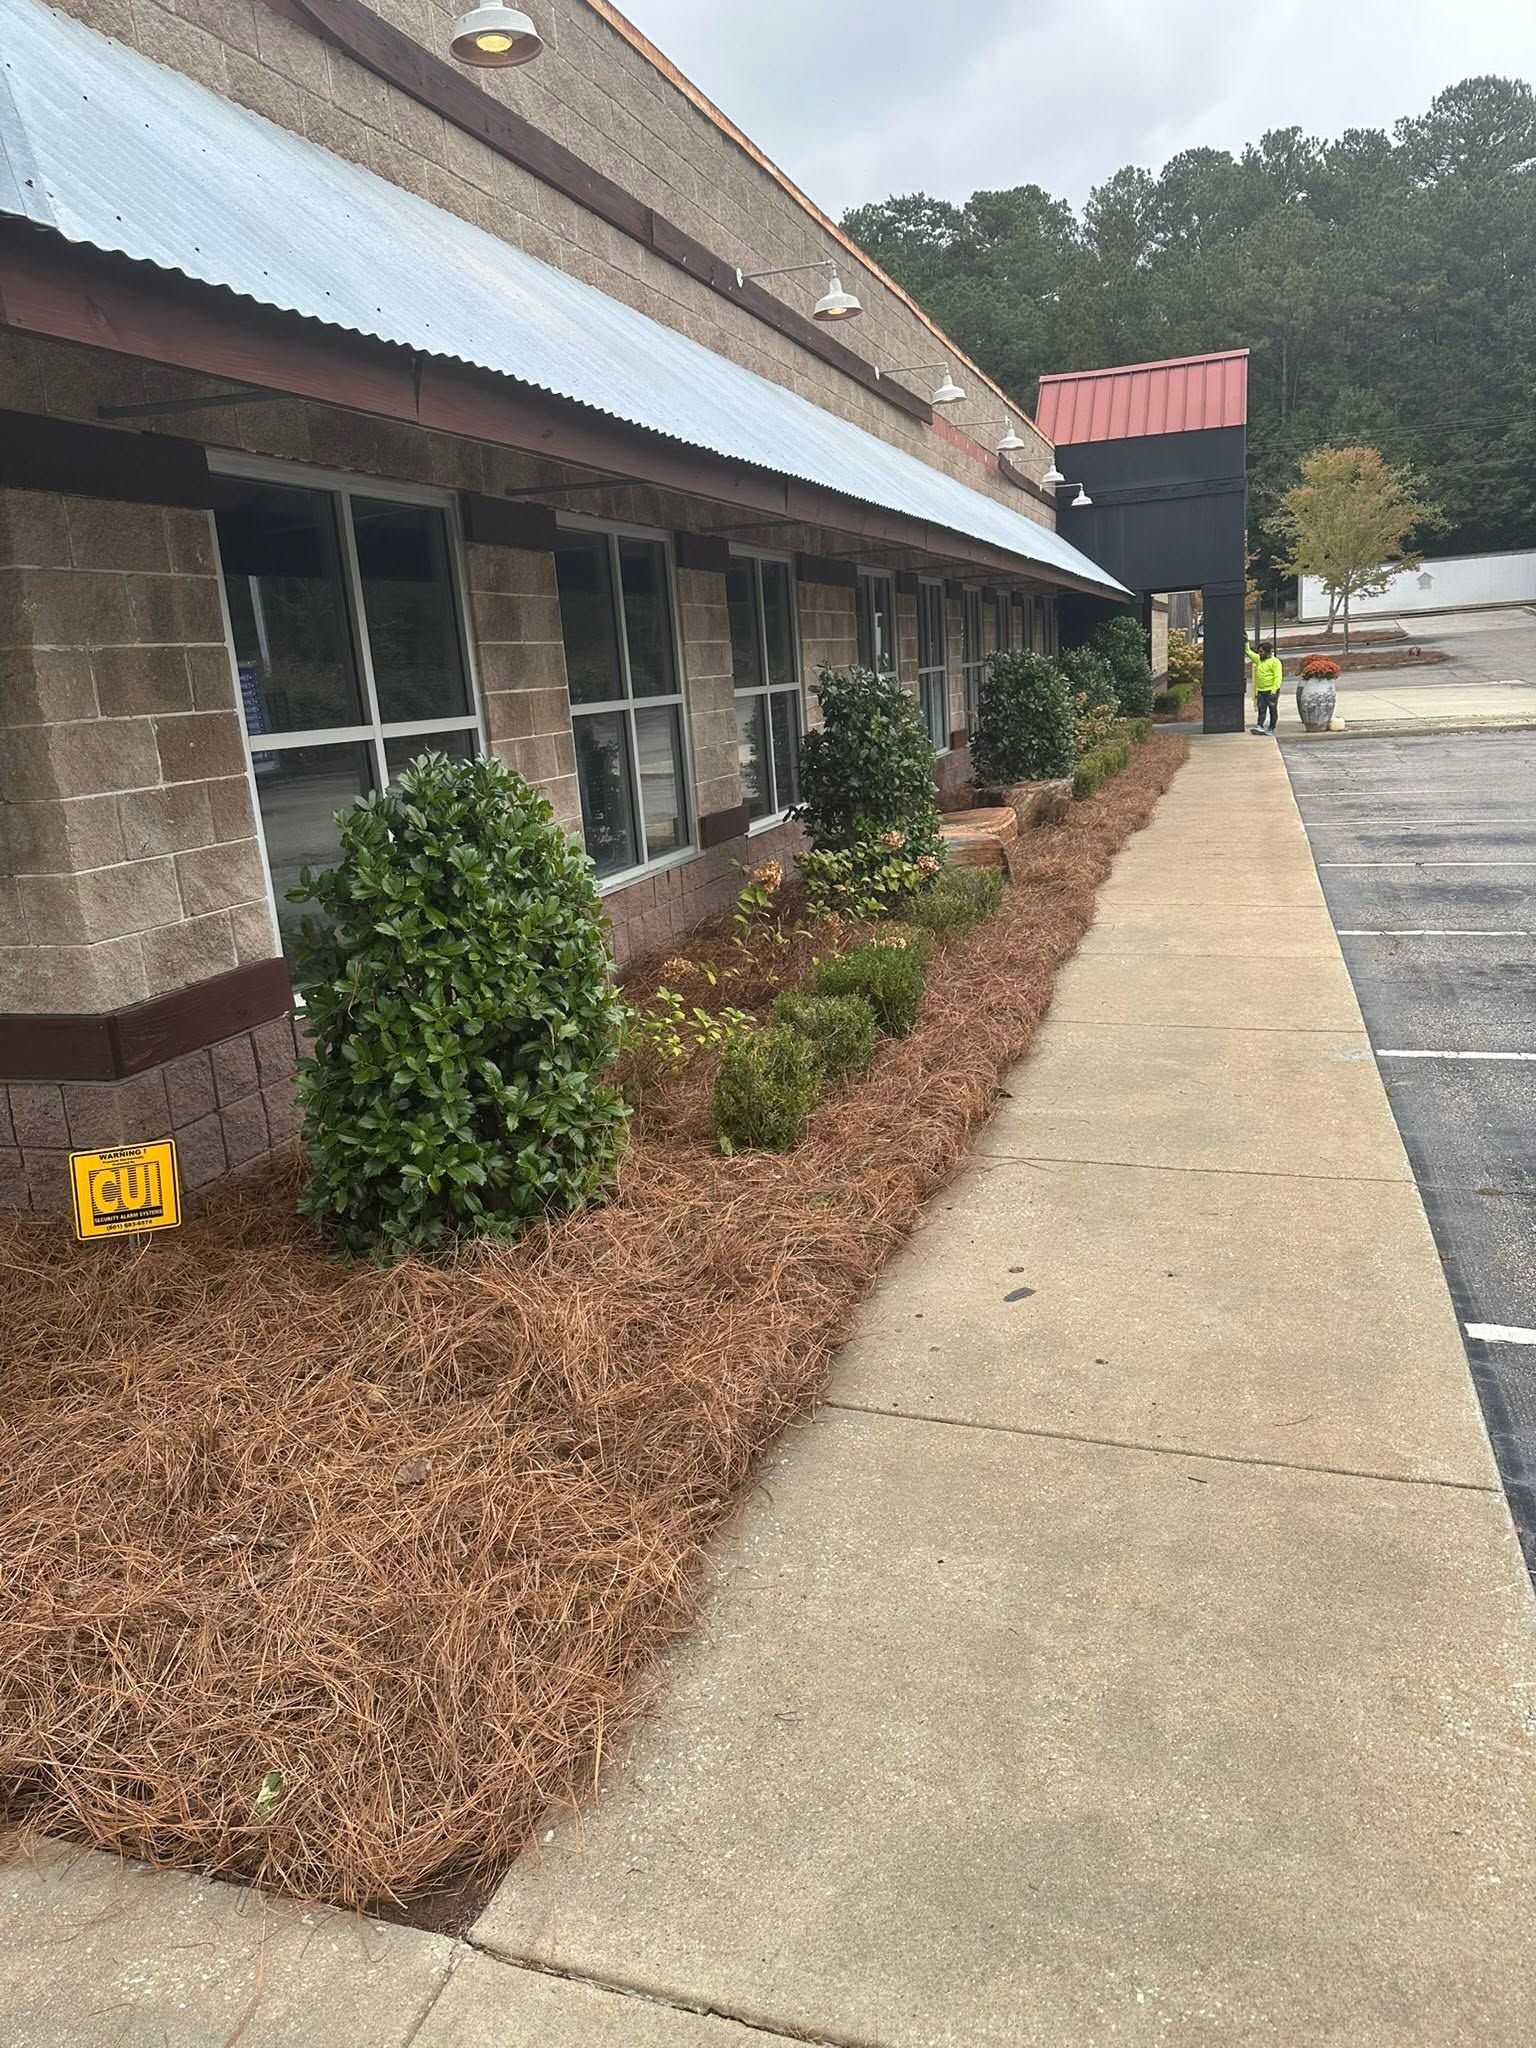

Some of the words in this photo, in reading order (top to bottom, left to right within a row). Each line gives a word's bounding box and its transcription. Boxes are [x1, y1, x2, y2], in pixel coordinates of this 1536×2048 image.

[99, 1150, 141, 1160] WARNING
[93, 1162, 161, 1212] CUI
[94, 1215, 119, 1223] SECURITY
[120, 1212, 139, 1220] ALARM
[140, 1208, 162, 1217] SYSTEMS
